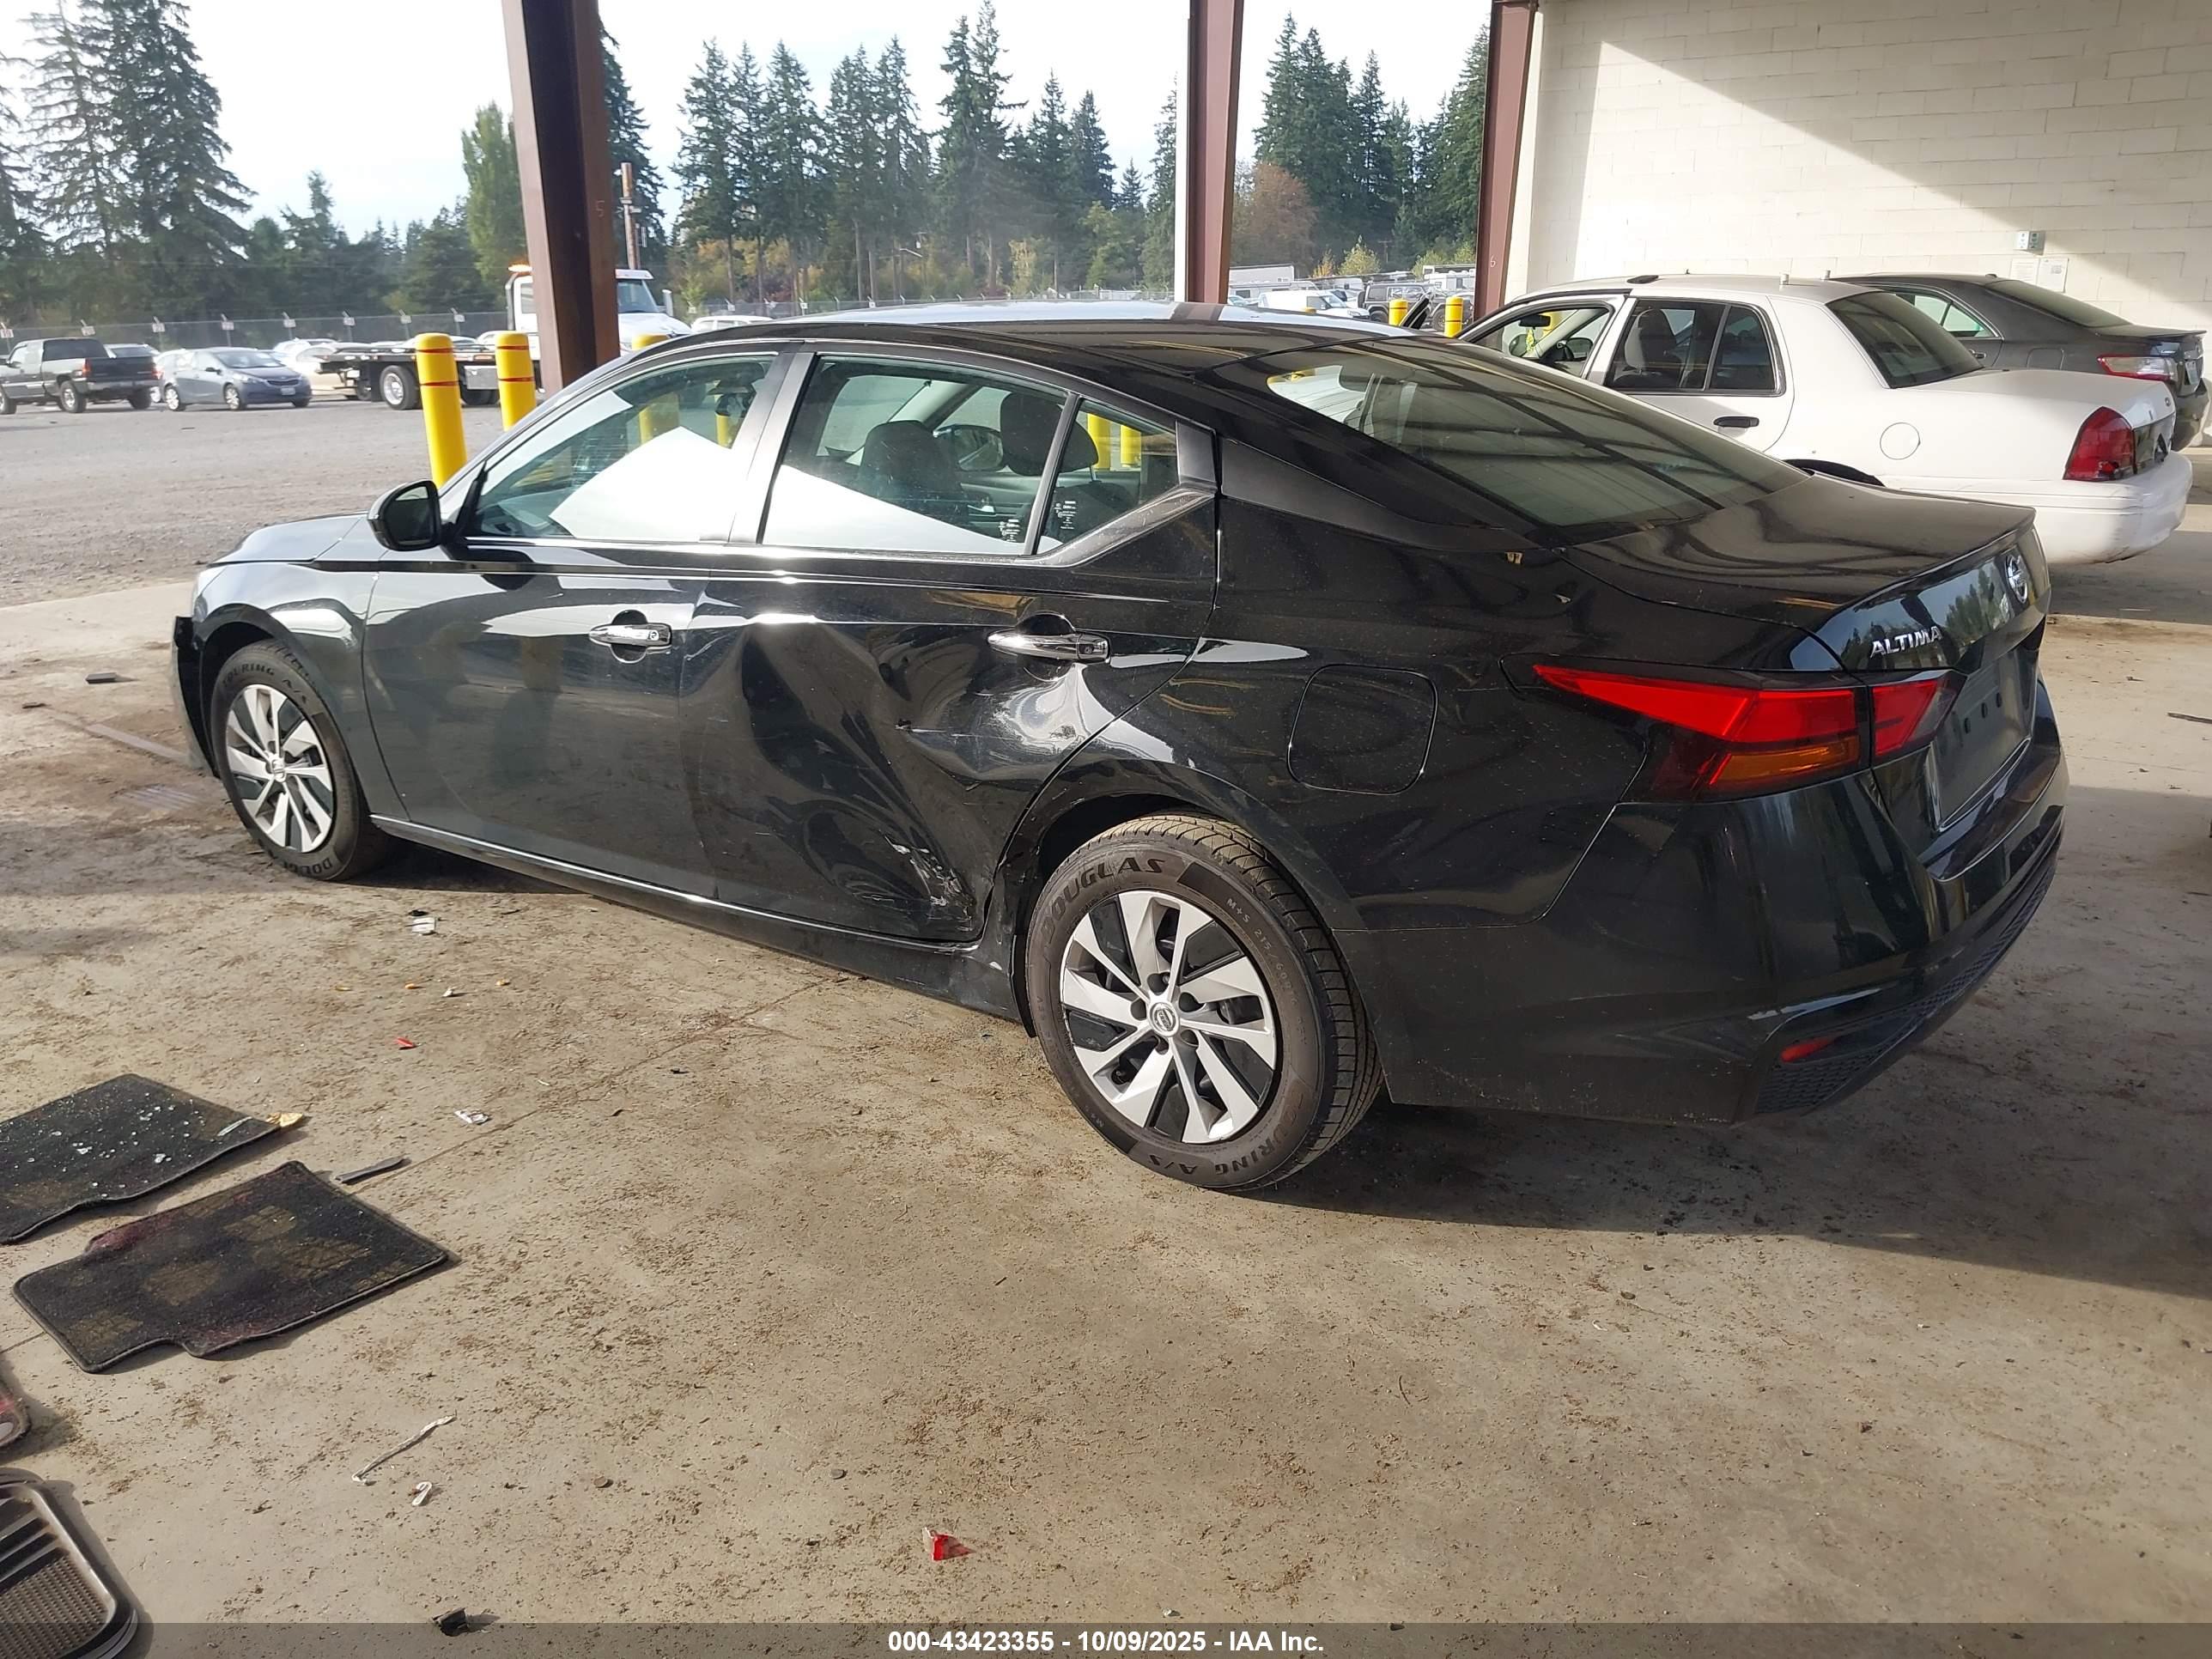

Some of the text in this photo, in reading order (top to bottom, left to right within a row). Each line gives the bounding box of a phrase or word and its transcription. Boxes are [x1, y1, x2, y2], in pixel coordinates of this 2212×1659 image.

[1870, 626, 1942, 659] ALTIMA
[1041, 857, 1166, 944] DOUGLAS
[1226, 898, 1251, 923] M+S
